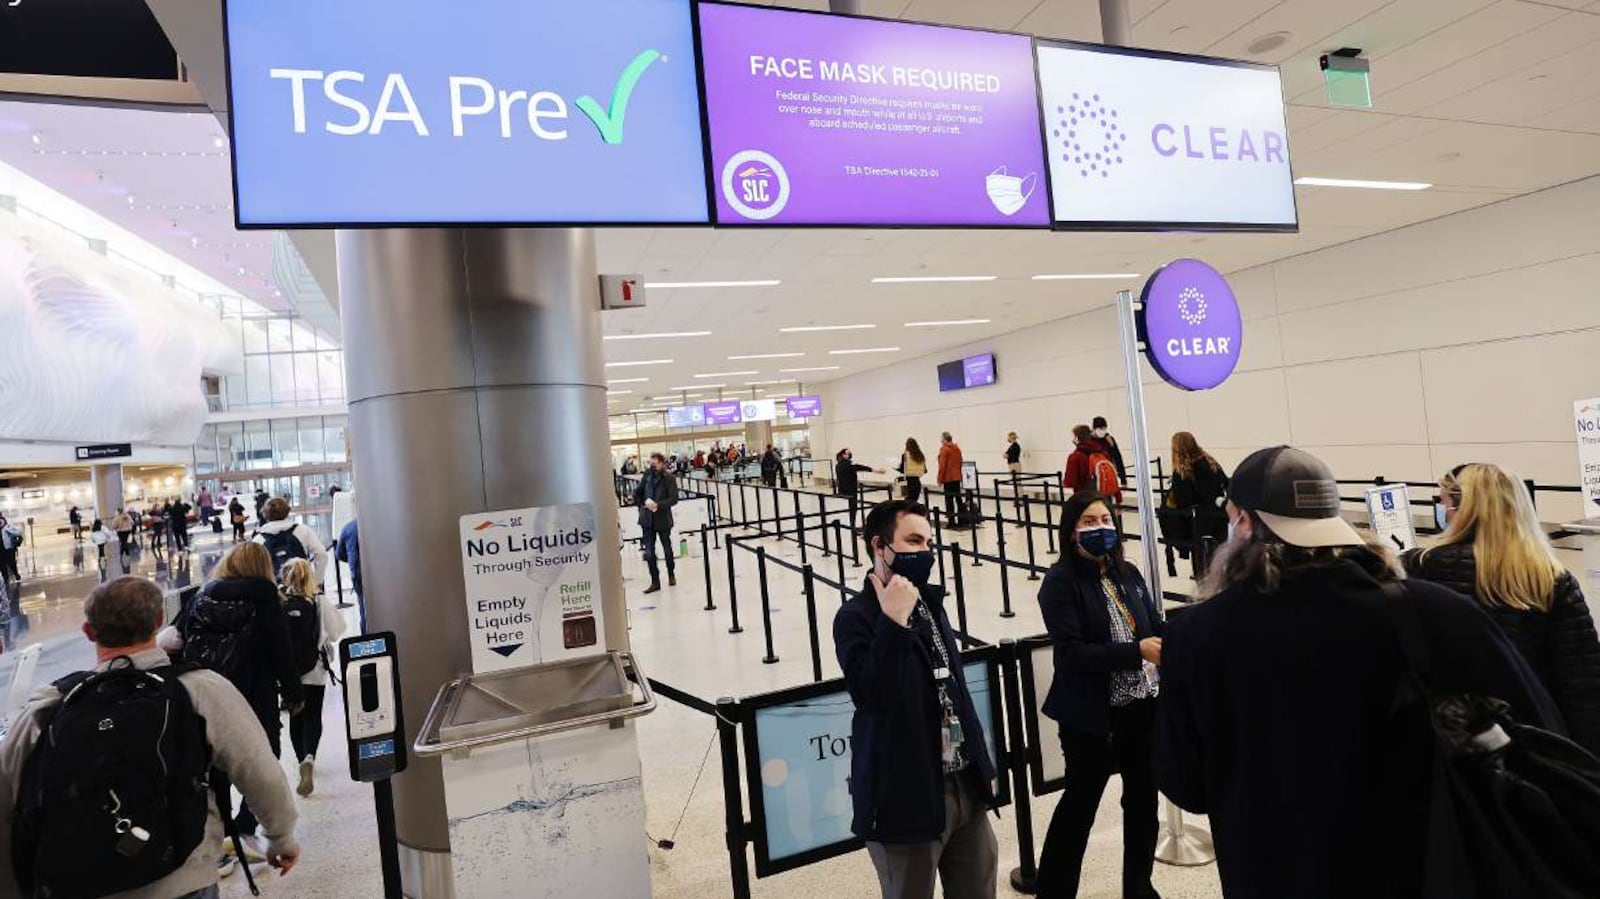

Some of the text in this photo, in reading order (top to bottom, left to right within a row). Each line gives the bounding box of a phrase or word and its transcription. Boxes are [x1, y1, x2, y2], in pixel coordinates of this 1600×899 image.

[750, 55, 1000, 93] FACE MASK REQUIRED
[270, 68, 568, 141] TSA Pre
[775, 89, 810, 102] Federal
[812, 92, 848, 105] Security
[850, 95, 887, 105] Directive
[778, 104, 799, 113] over
[800, 105, 823, 114] nose
[824, 107, 841, 116] and
[843, 108, 871, 117] mouth
[807, 118, 840, 128] aboard
[842, 120, 886, 131] scheduled
[888, 123, 930, 135] passenger
[1151, 123, 1285, 164] CLEAR
[863, 166, 899, 177] Directive
[742, 179, 770, 202] SLC
[1577, 418, 1594, 433] No
[467, 528, 593, 558] No Liquids
[473, 551, 590, 575] Through Security
[560, 581, 591, 595] Refill
[477, 595, 526, 613] Empty
[561, 593, 591, 606] Here
[475, 612, 532, 630] Liquids
[486, 630, 524, 644] Here
